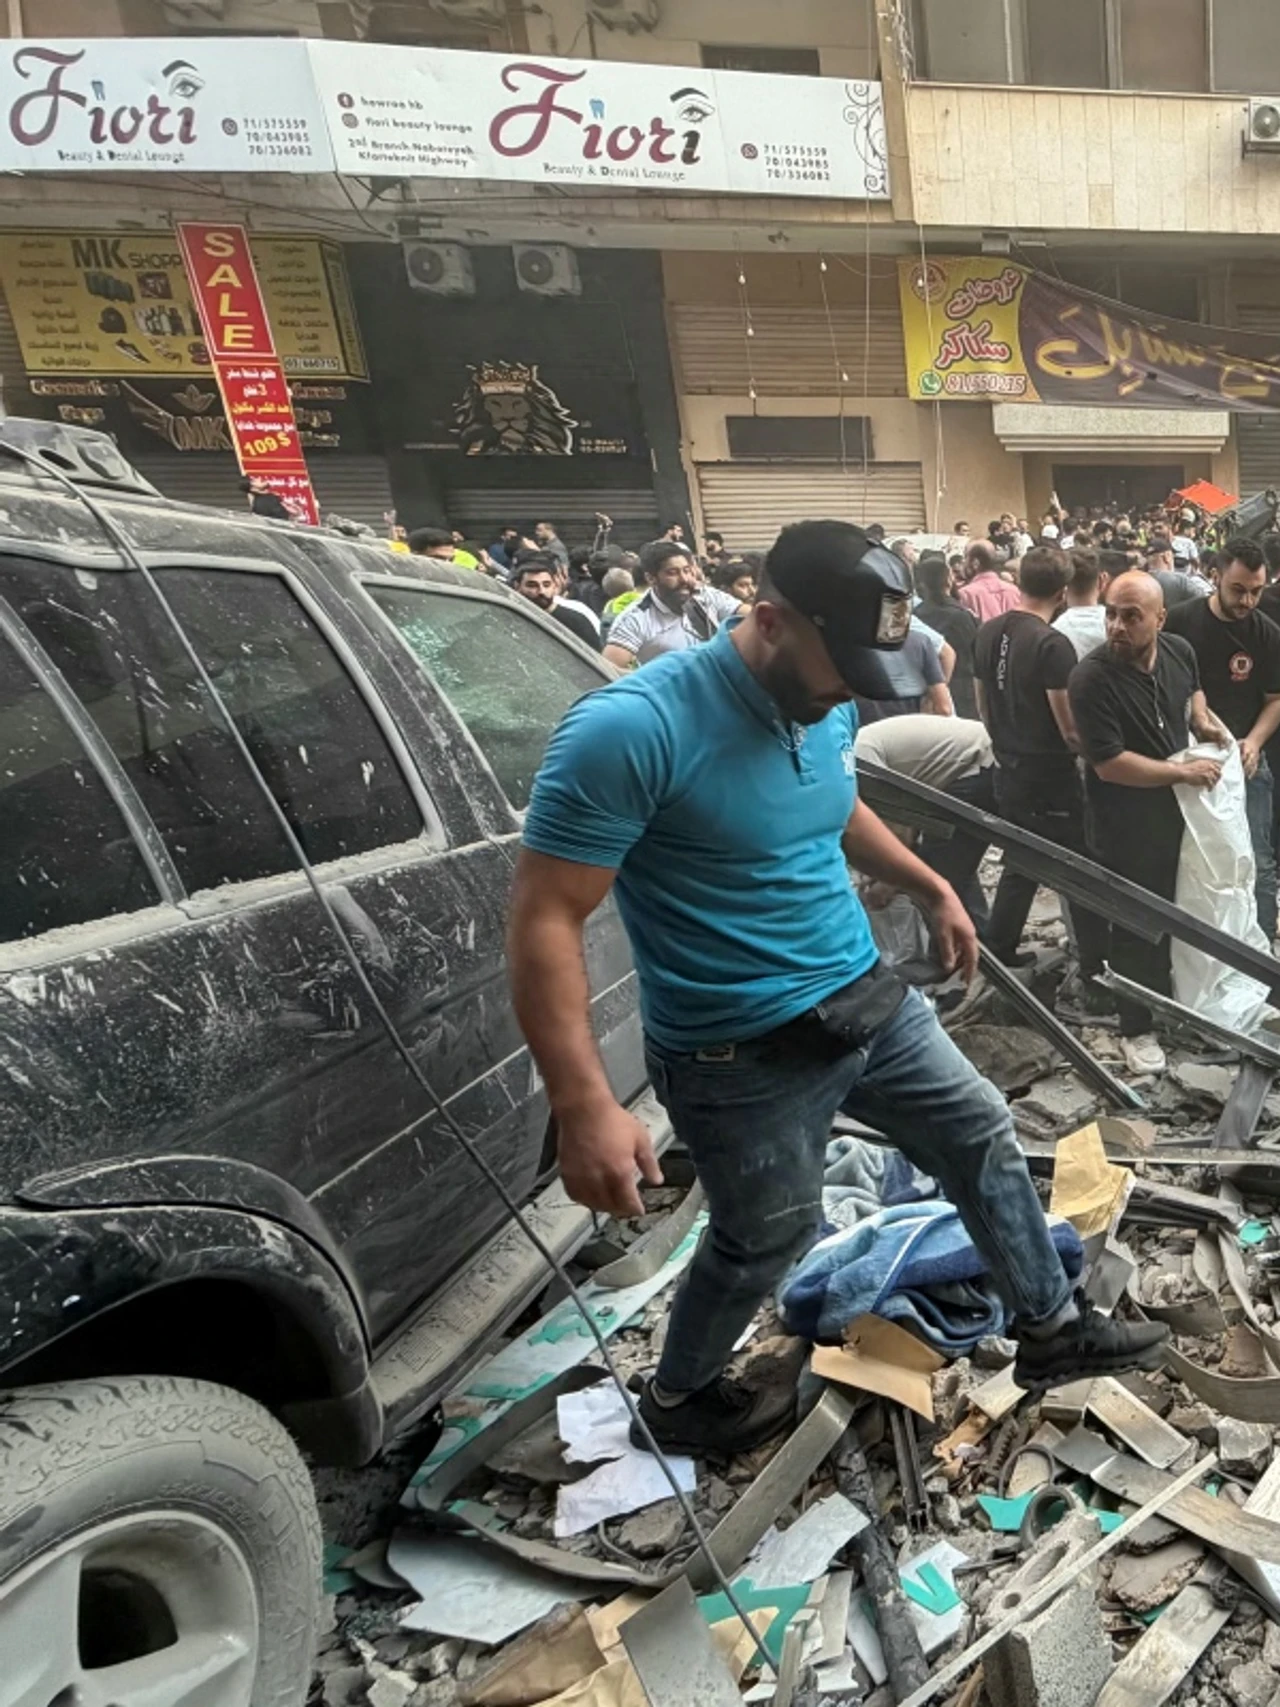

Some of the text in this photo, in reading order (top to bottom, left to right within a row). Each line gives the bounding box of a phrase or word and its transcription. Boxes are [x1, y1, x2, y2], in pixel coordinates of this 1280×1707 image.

[9, 47, 197, 146] Fiori
[365, 116, 473, 134] fiori beauty lounge
[489, 63, 701, 165] Fiori
[58, 149, 185, 163] Beauty & Dental Lounge
[418, 155, 469, 168] Highway
[543, 162, 686, 181] Beauty & Dental Lounge
[71, 239, 128, 269] MK
[203, 231, 256, 349] SALE
[935, 322, 1011, 368] سكاكر
[257, 383, 268, 396] 3
[243, 432, 292, 456] 109$
